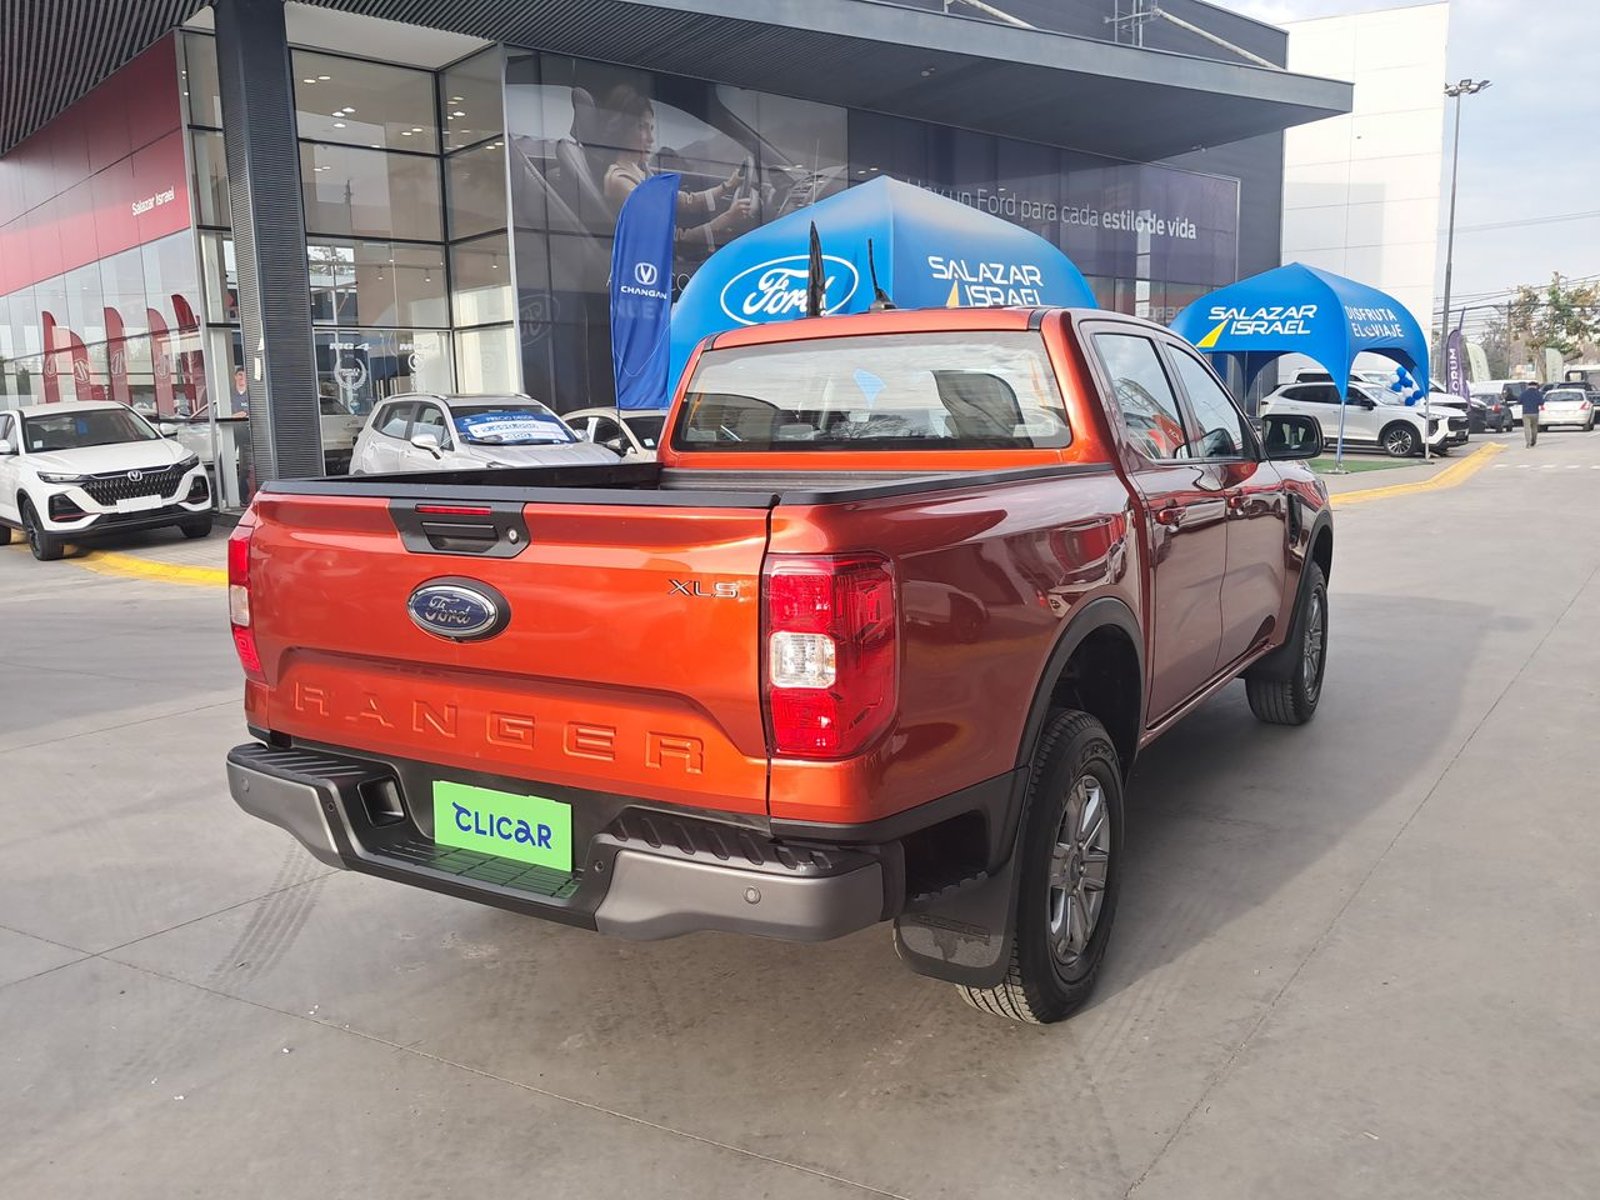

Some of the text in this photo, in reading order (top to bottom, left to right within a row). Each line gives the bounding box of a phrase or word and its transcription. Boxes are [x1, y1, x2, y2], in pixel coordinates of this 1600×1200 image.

[132, 186, 174, 216] Salazar Israel
[977, 188, 1016, 216] Ford
[1020, 200, 1057, 221] para
[1061, 204, 1098, 227] cada
[1102, 209, 1144, 233] estilo
[1147, 213, 1165, 235] de
[1167, 216, 1197, 240] vida
[927, 255, 1044, 287] SALAZAR
[620, 285, 667, 300] CHANGAN
[1207, 304, 1318, 320] SALAZAR
[1344, 305, 1398, 321] DISFRUTA
[1230, 319, 1311, 335] ISRAEL
[1371, 323, 1405, 338] VIAJE
[667, 579, 738, 598] XLS
[425, 595, 472, 625] Ford
[294, 681, 705, 775] RANGER
